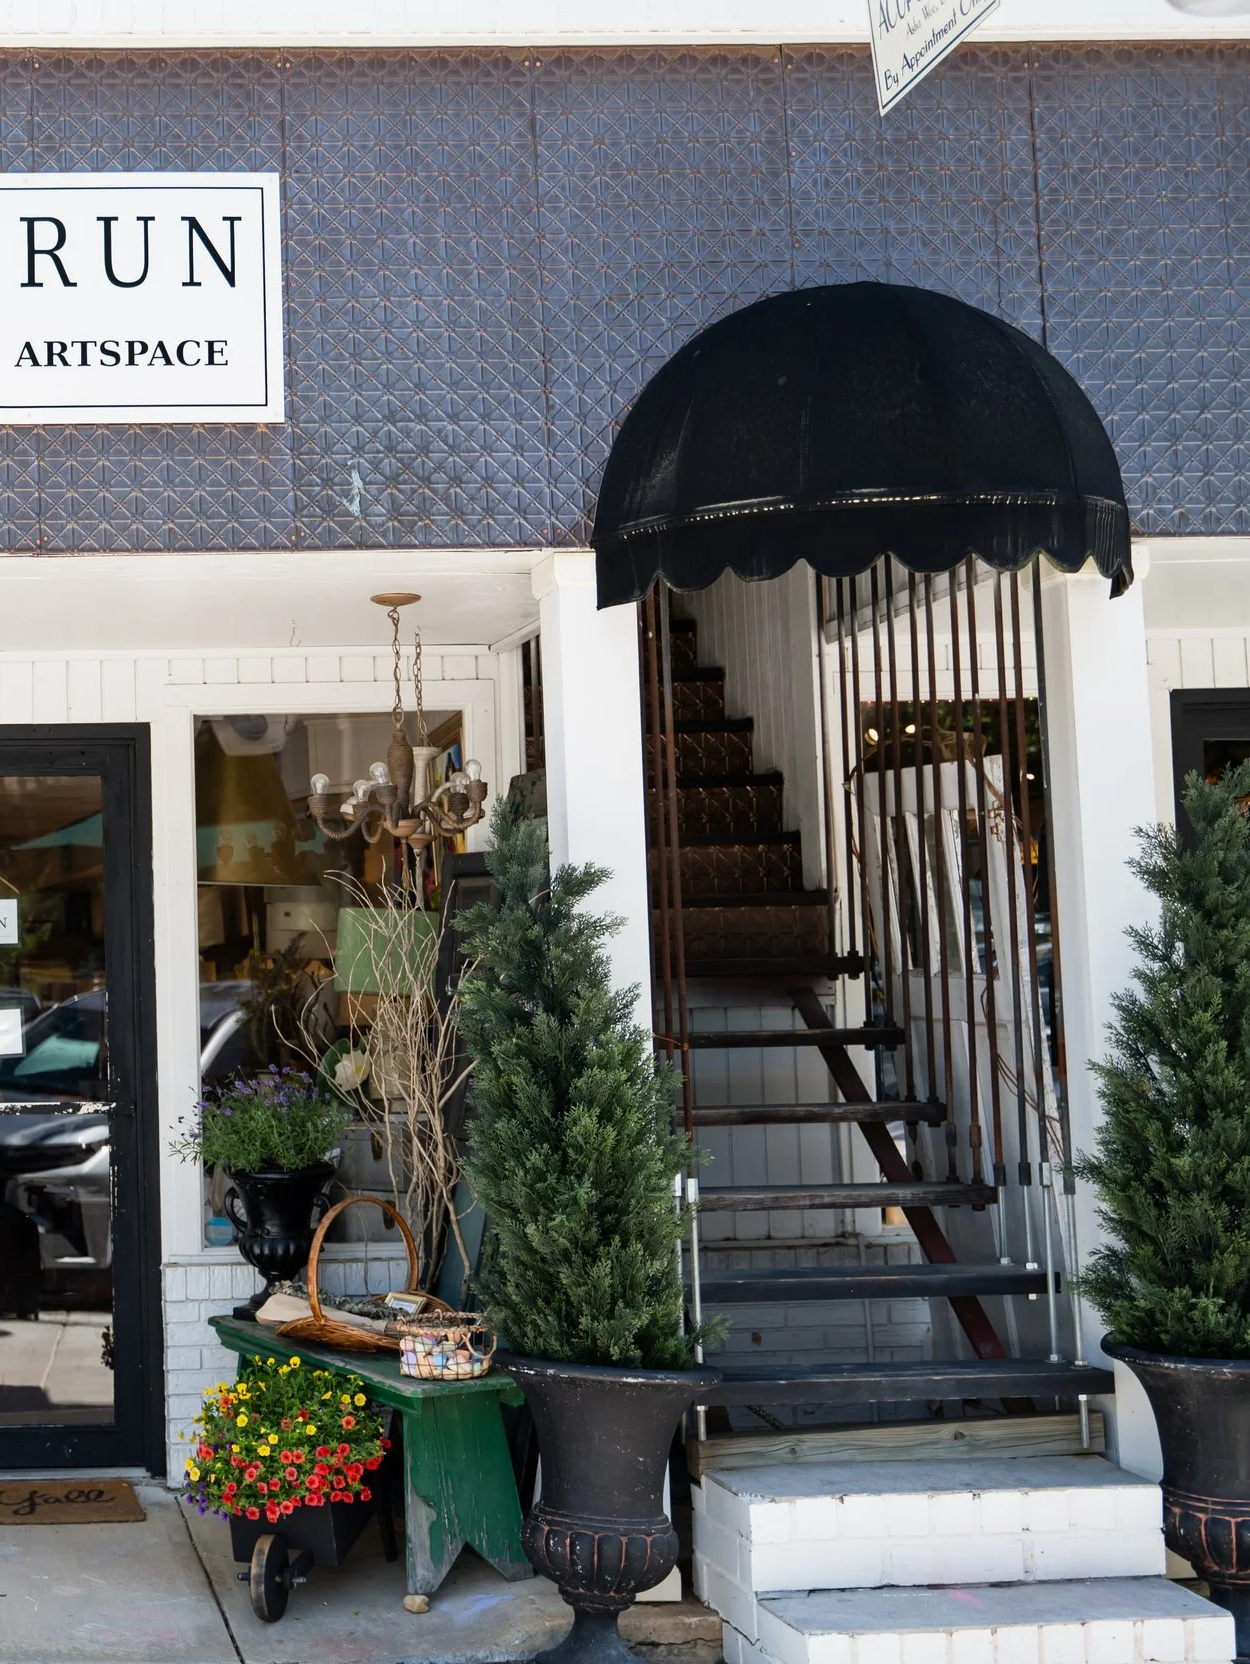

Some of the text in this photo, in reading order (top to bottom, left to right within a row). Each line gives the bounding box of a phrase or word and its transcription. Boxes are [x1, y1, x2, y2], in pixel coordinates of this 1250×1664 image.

[883, 68, 899, 92] By
[901, 8, 958, 77] Appointment
[20, 217, 241, 288] RUN
[15, 340, 228, 367] ARTSPACE
